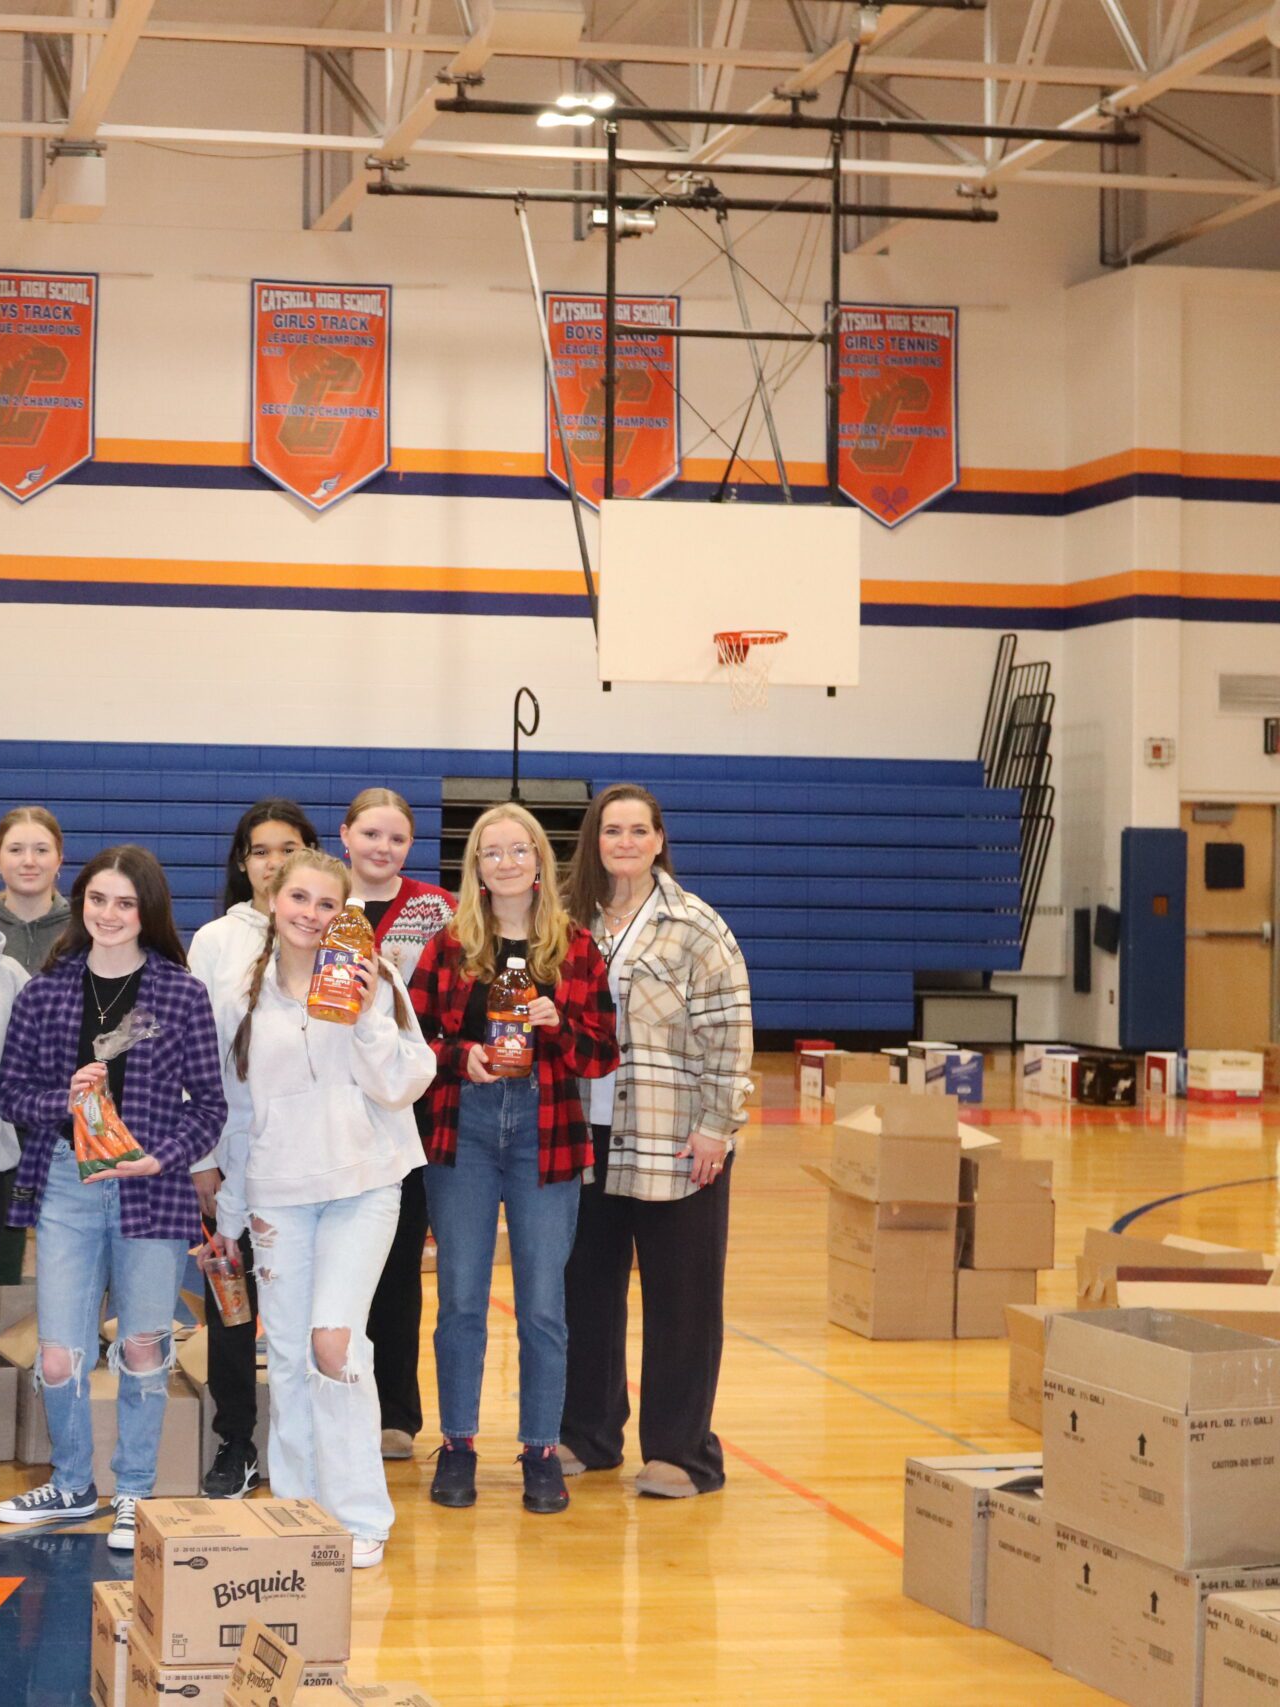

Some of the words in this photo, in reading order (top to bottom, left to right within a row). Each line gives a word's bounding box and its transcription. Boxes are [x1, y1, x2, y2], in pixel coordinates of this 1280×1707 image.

[20, 280, 47, 298] HIGH
[48, 281, 90, 305] SCHOOL
[261, 288, 314, 312] CATSKILL
[316, 290, 342, 309] HIGH
[343, 292, 384, 316] SCHOOL
[23, 304, 73, 320] TRACK
[552, 301, 604, 323] CATSKILL
[632, 304, 673, 328] SCHOOL
[16, 323, 81, 336] CHAMPIONS
[273, 314, 316, 329] GIRLS
[320, 315, 369, 331] TRACK
[839, 312, 883, 333] ATSKILL
[885, 313, 911, 331] HIGH
[911, 315, 951, 338] SCHOOL
[267, 333, 309, 345] LEAGUE
[312, 335, 376, 347] CHAMPIONS
[565, 325, 603, 341] BOYS
[559, 343, 600, 356] LEAGUE
[614, 344, 665, 358] AMPIONS
[845, 335, 886, 350] GIRLS
[889, 337, 940, 352] TENNIS
[883, 355, 944, 368] CHAMPIONS
[23, 395, 84, 409] CHAMPIONS
[261, 403, 305, 416] SECTION
[318, 406, 379, 419] CHAMPIONS
[613, 415, 670, 429] HAMPIONS
[839, 424, 878, 435] ECTION
[890, 426, 947, 438] CHAMPIONS
[1044, 1391, 1054, 1401] PET
[1190, 1433, 1205, 1442] PET
[311, 1550, 340, 1559] 42070
[212, 1569, 306, 1609] Bisquick
[1207, 1618, 1219, 1631] PET
[303, 1678, 333, 1687] 42070
